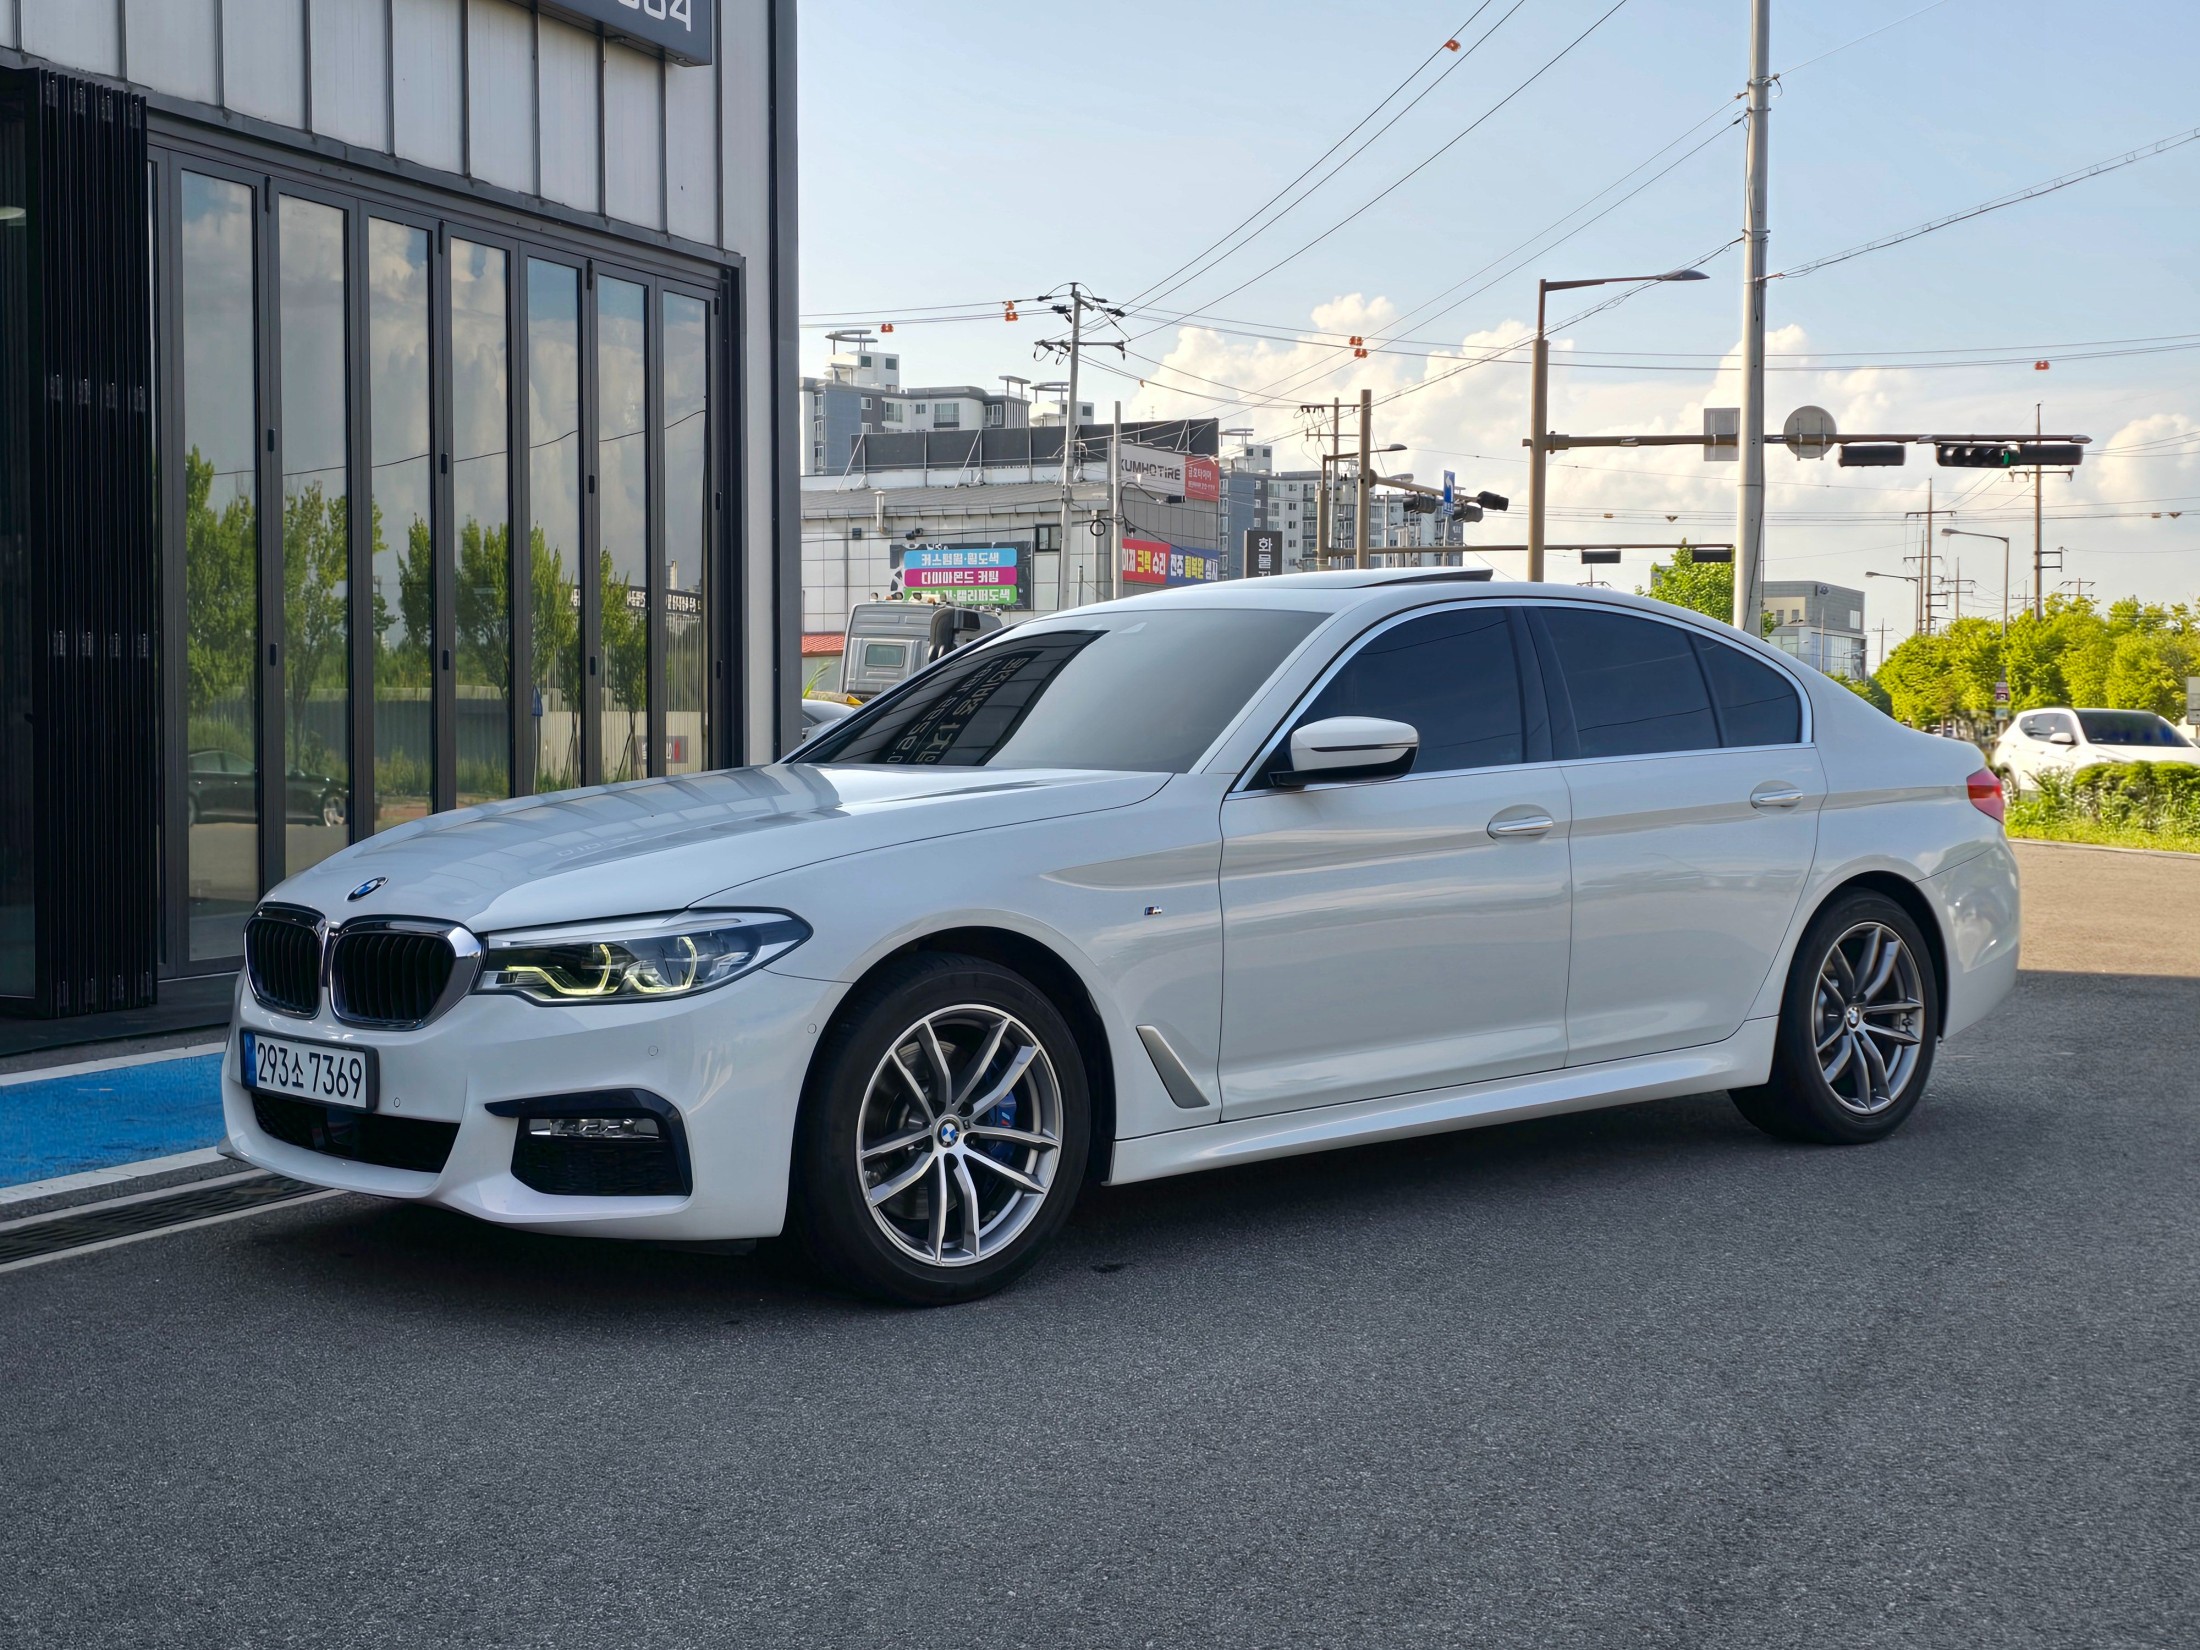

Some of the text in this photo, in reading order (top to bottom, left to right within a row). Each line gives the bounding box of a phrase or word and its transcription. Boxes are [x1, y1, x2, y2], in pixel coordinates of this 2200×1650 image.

[1152, 551, 1166, 575] 수리
[1170, 554, 1184, 577] 전주
[921, 571, 974, 584] 다이아몬드
[257, 1042, 362, 1099] 293소 7369
